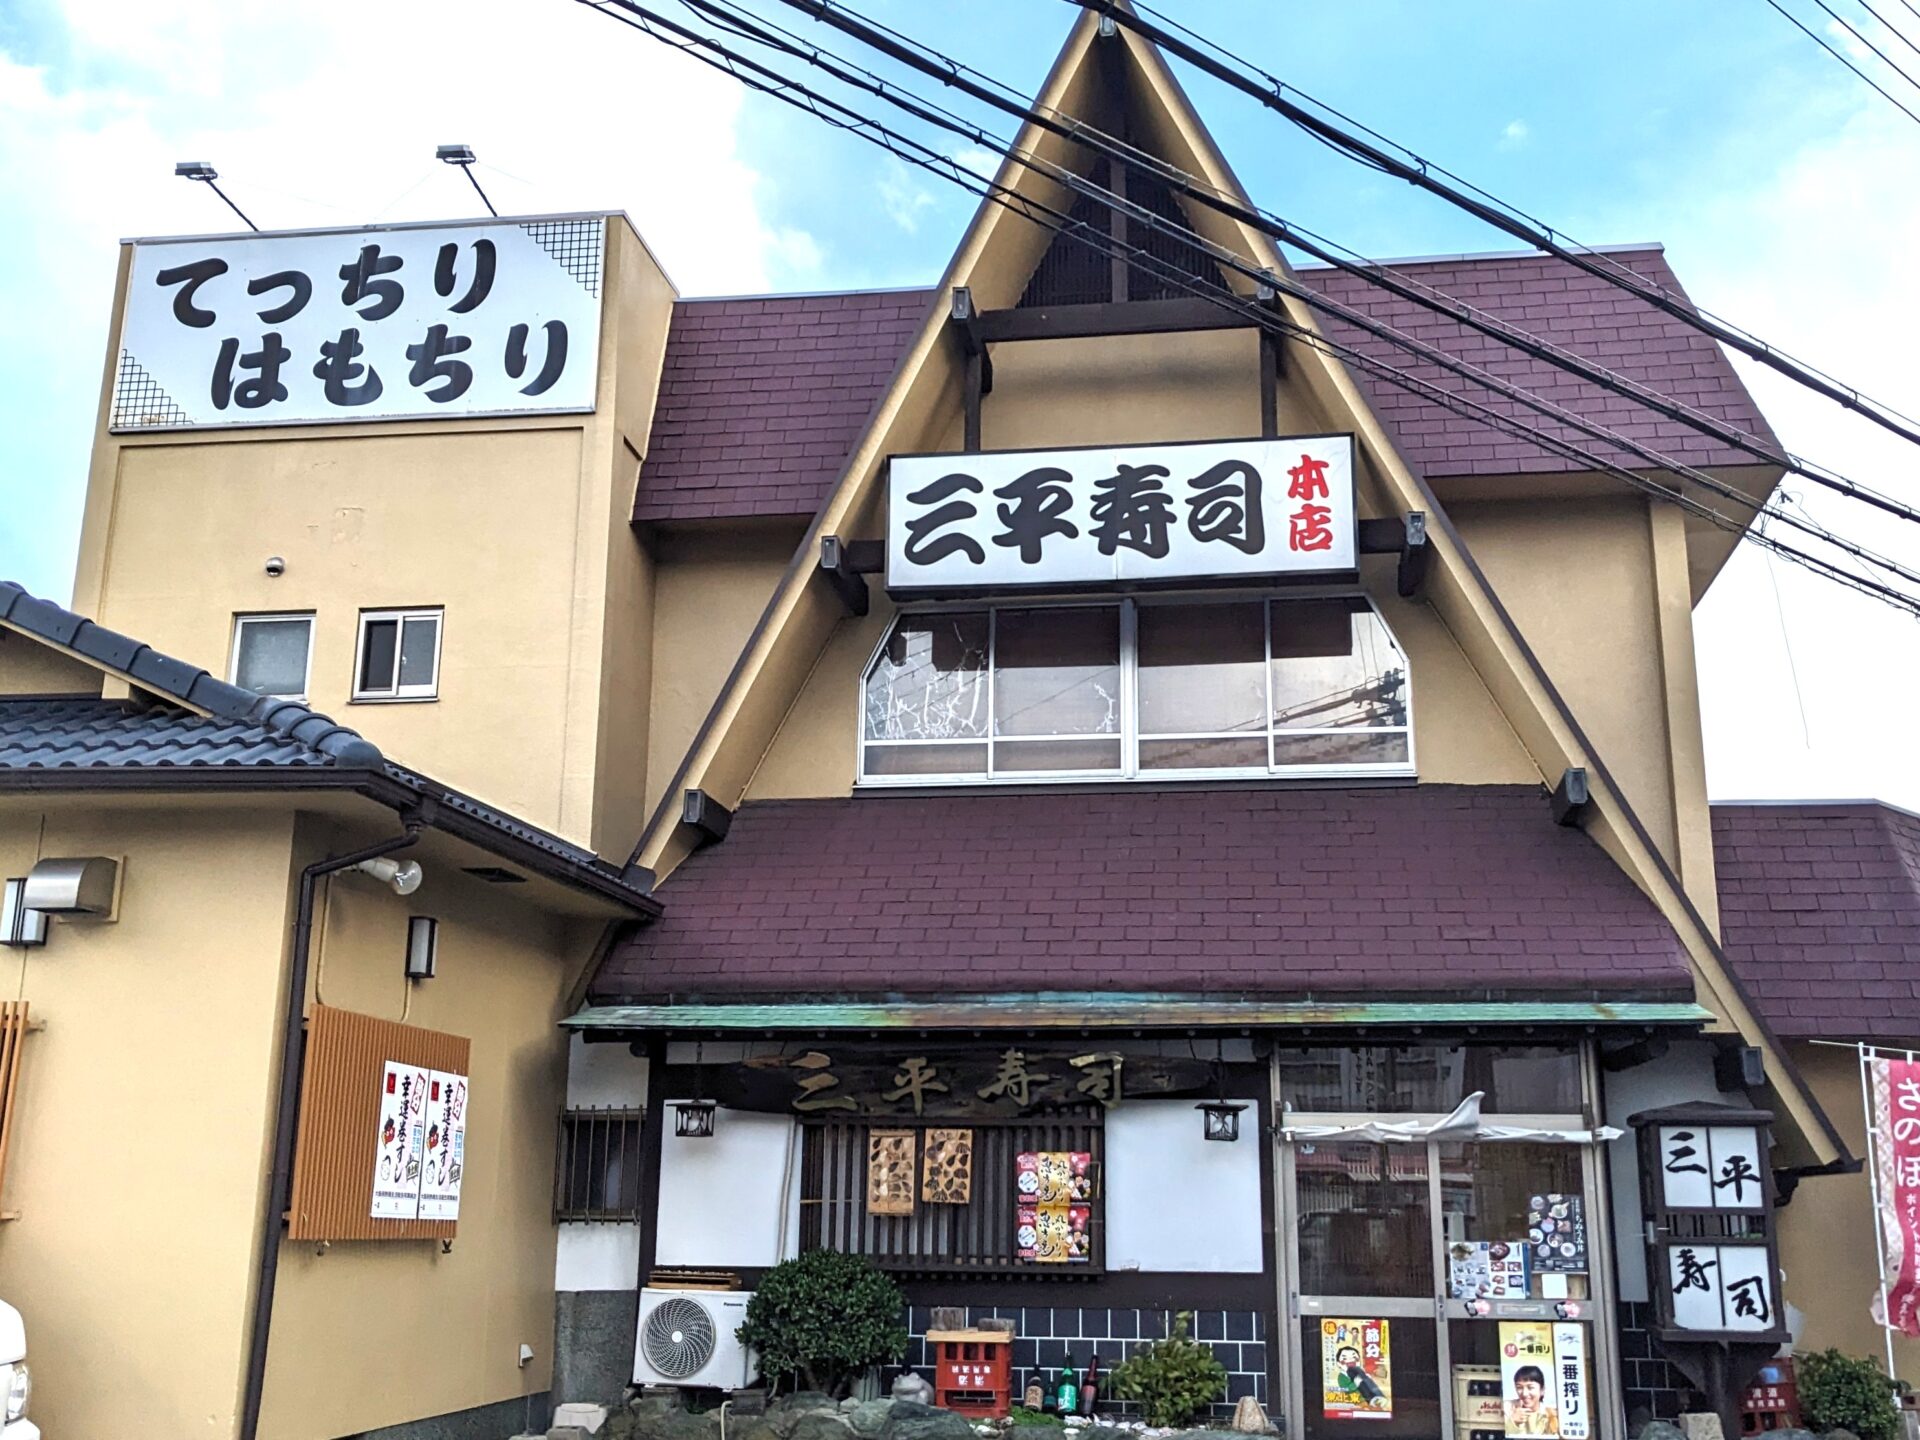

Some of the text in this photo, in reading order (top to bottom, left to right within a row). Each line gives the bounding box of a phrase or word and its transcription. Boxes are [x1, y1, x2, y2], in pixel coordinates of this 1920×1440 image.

[156, 238, 497, 328] てっちり
[211, 319, 568, 410] はもちり
[904, 459, 1266, 565] 三平寿司
[1287, 454, 1332, 552] 本店
[791, 1048, 1124, 1116] 三平寿司
[1665, 1131, 1761, 1203] 三平
[1673, 1249, 1769, 1323] 寿司
[1365, 1328, 1380, 1357] 節分
[1519, 1344, 1551, 1354] 一番搾り
[1562, 1356, 1580, 1415] 一番搾り
